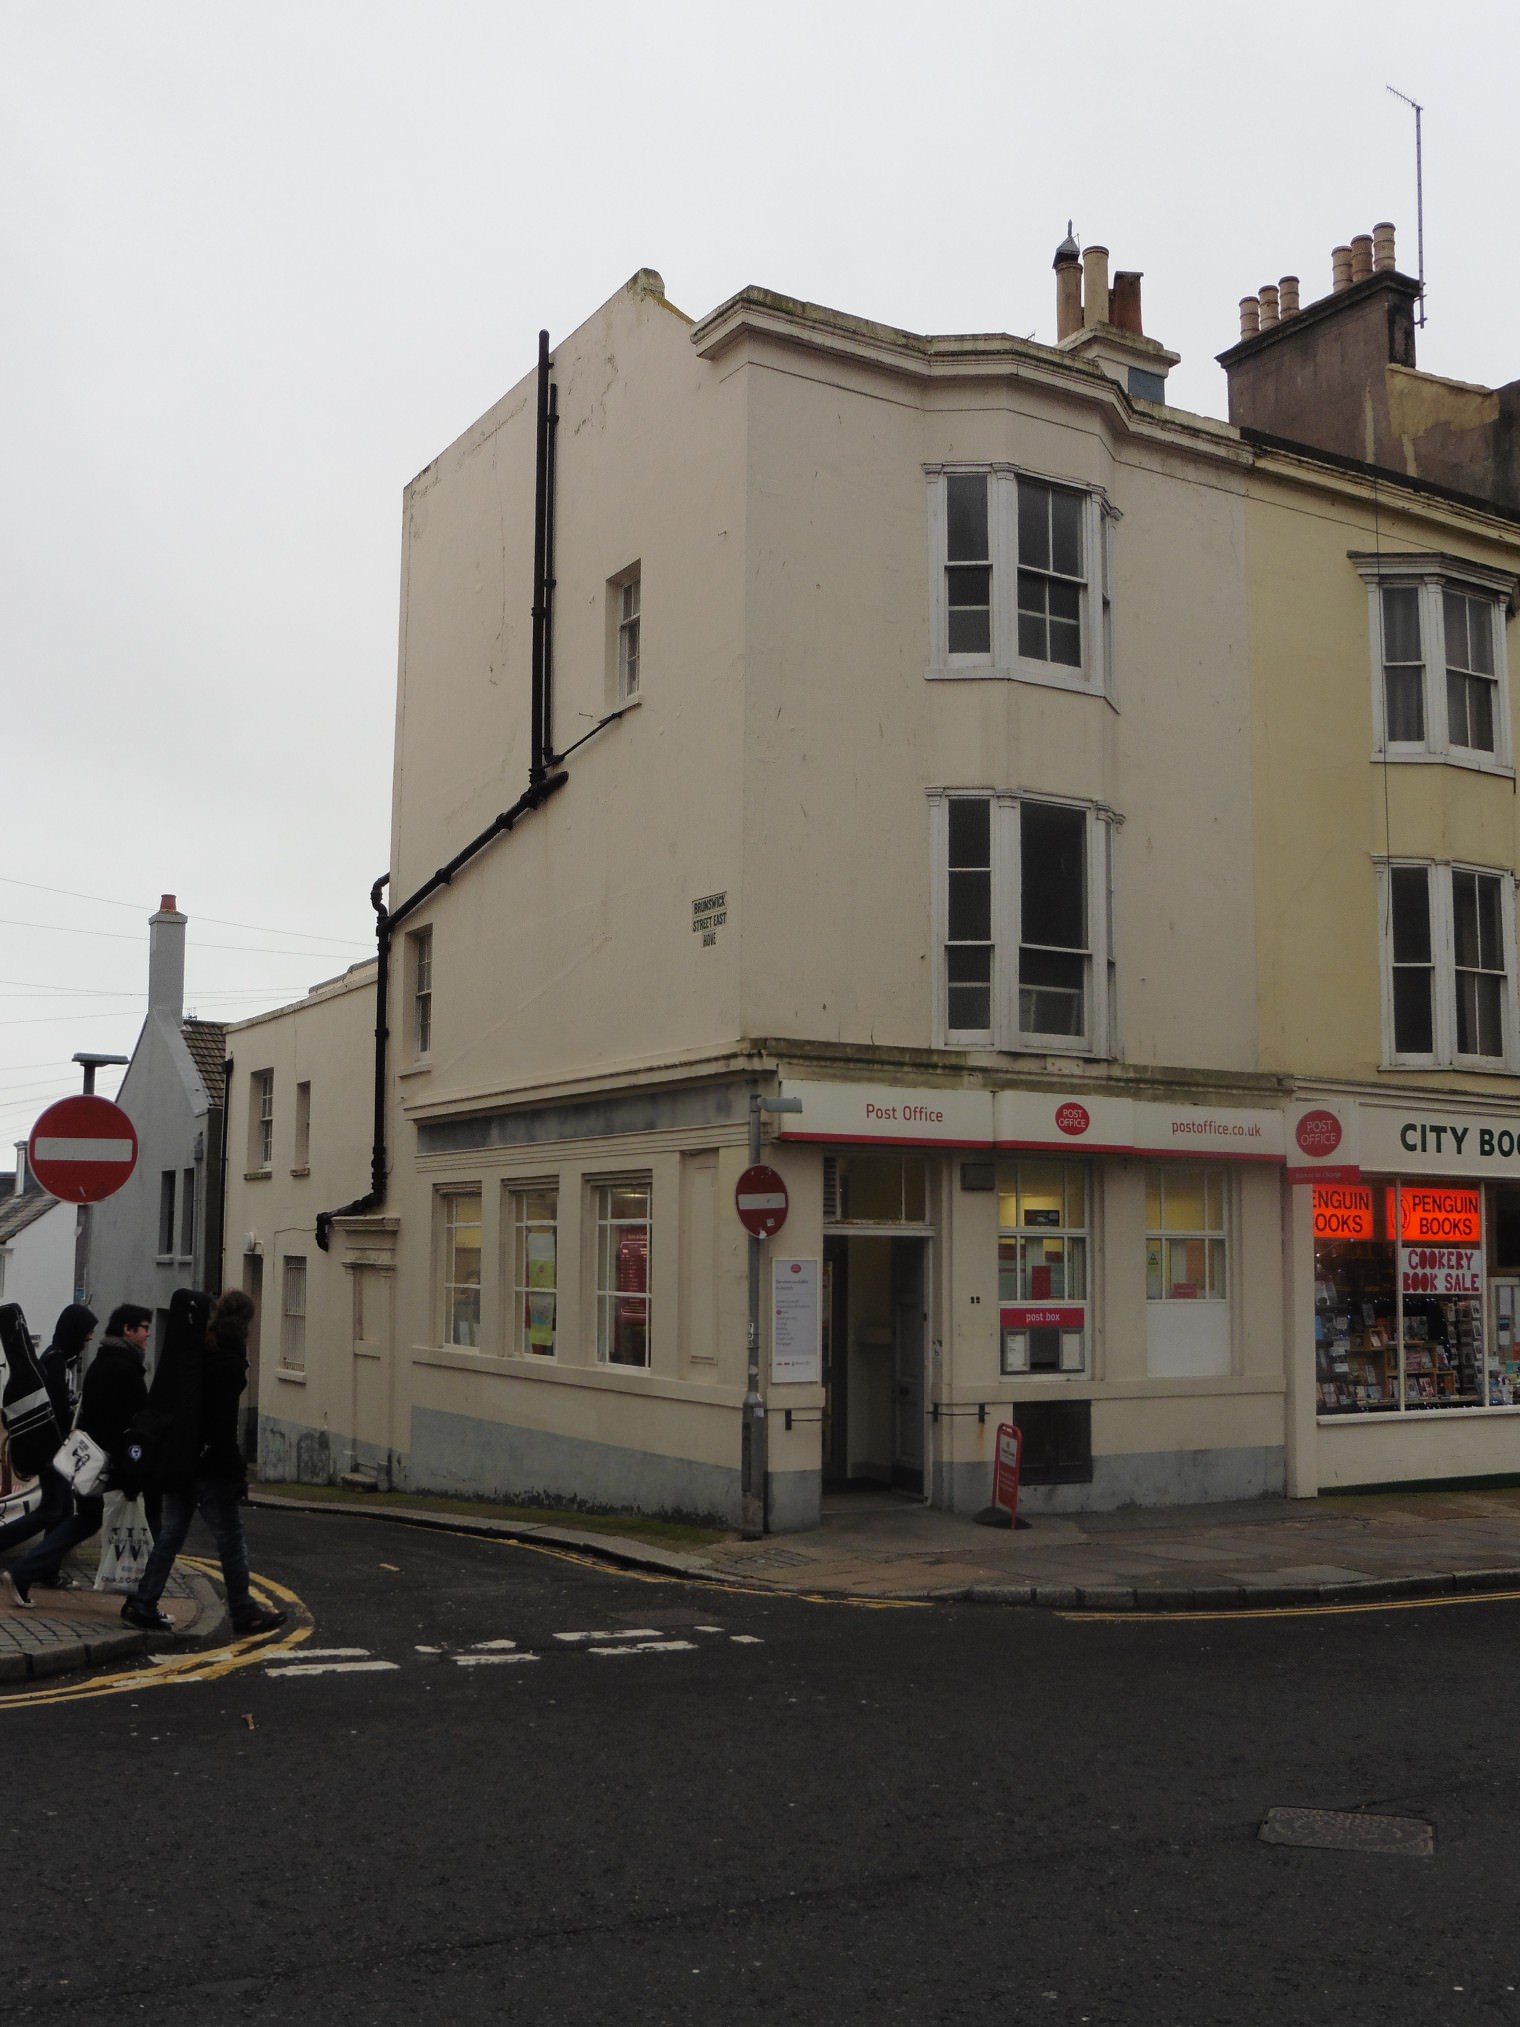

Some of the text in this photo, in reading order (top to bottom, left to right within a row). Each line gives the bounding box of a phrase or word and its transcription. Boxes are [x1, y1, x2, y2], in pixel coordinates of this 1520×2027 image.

[694, 894, 726, 914] BRUNSWICK
[693, 912, 726, 932] STREET EAST
[703, 933, 716, 947] HOVE
[866, 1103, 944, 1122] Post Office
[1062, 1109, 1082, 1118] POST
[1058, 1118, 1087, 1128] OFFICE
[1171, 1120, 1262, 1137] postoffice.co.uk
[1306, 1119, 1333, 1132] POST
[1300, 1132, 1337, 1146] OFFICE
[1400, 1122, 1469, 1155] CITY
[1412, 1194, 1479, 1214] PENGUIN
[1315, 1213, 1363, 1233] OOKS
[1420, 1217, 1473, 1236] BOOKS
[1408, 1249, 1474, 1270] COOKERY
[1402, 1271, 1480, 1292] BOOK SALE
[1026, 1311, 1060, 1324] post box
